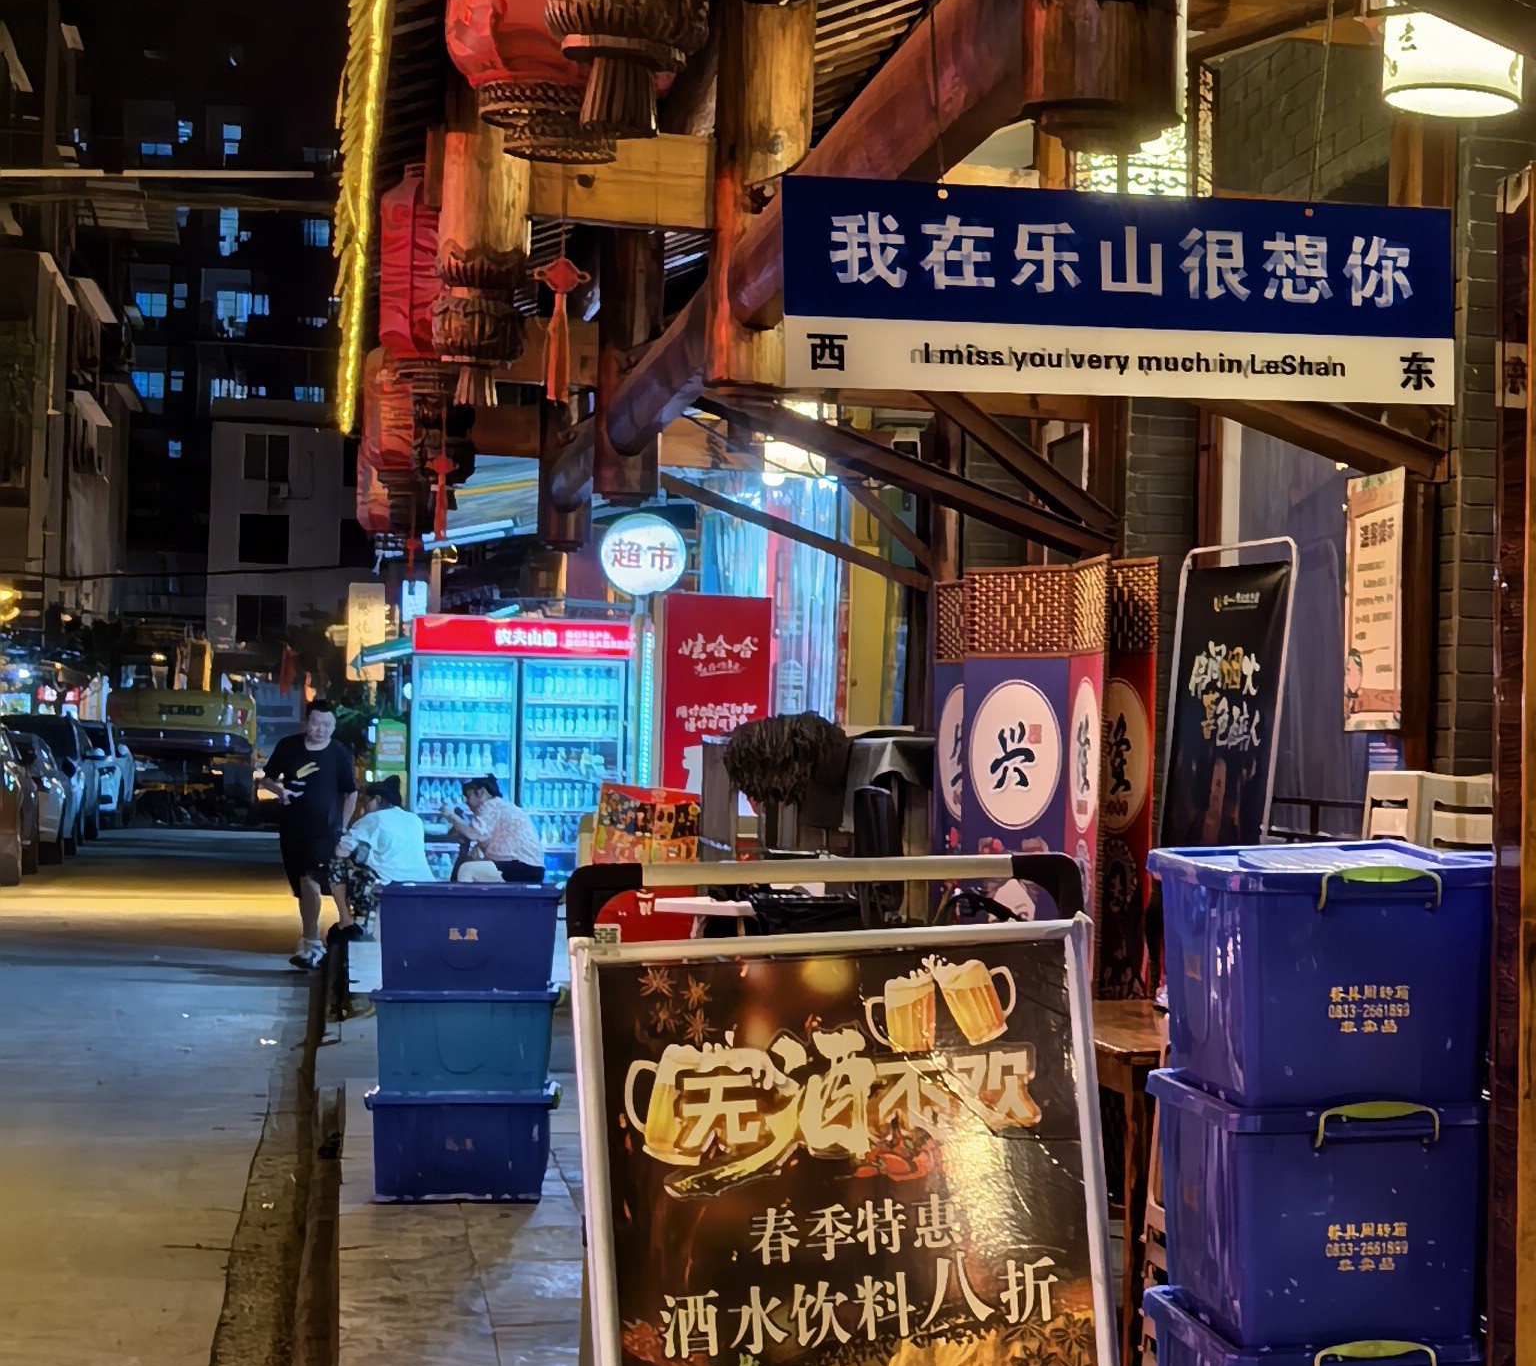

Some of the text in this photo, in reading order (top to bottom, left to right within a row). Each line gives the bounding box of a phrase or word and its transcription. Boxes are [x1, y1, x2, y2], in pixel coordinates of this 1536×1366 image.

[830, 211, 1412, 308] 我在乐山很想你
[807, 333, 848, 372] 西
[939, 344, 1004, 366] miss
[1011, 351, 1063, 373] you
[1072, 352, 1130, 376] very
[1138, 351, 1213, 374] much
[1219, 352, 1243, 375] in
[1252, 353, 1346, 378] LeShan
[1400, 352, 1435, 390] 东
[611, 537, 678, 572] 超市
[678, 632, 758, 659] 娃哈哈
[990, 720, 1035, 790] 兴
[676, 1028, 1032, 1175] 无酒不欢
[750, 1192, 961, 1266] 春季特惠
[659, 1251, 1060, 1360] 酒水饮料八折
